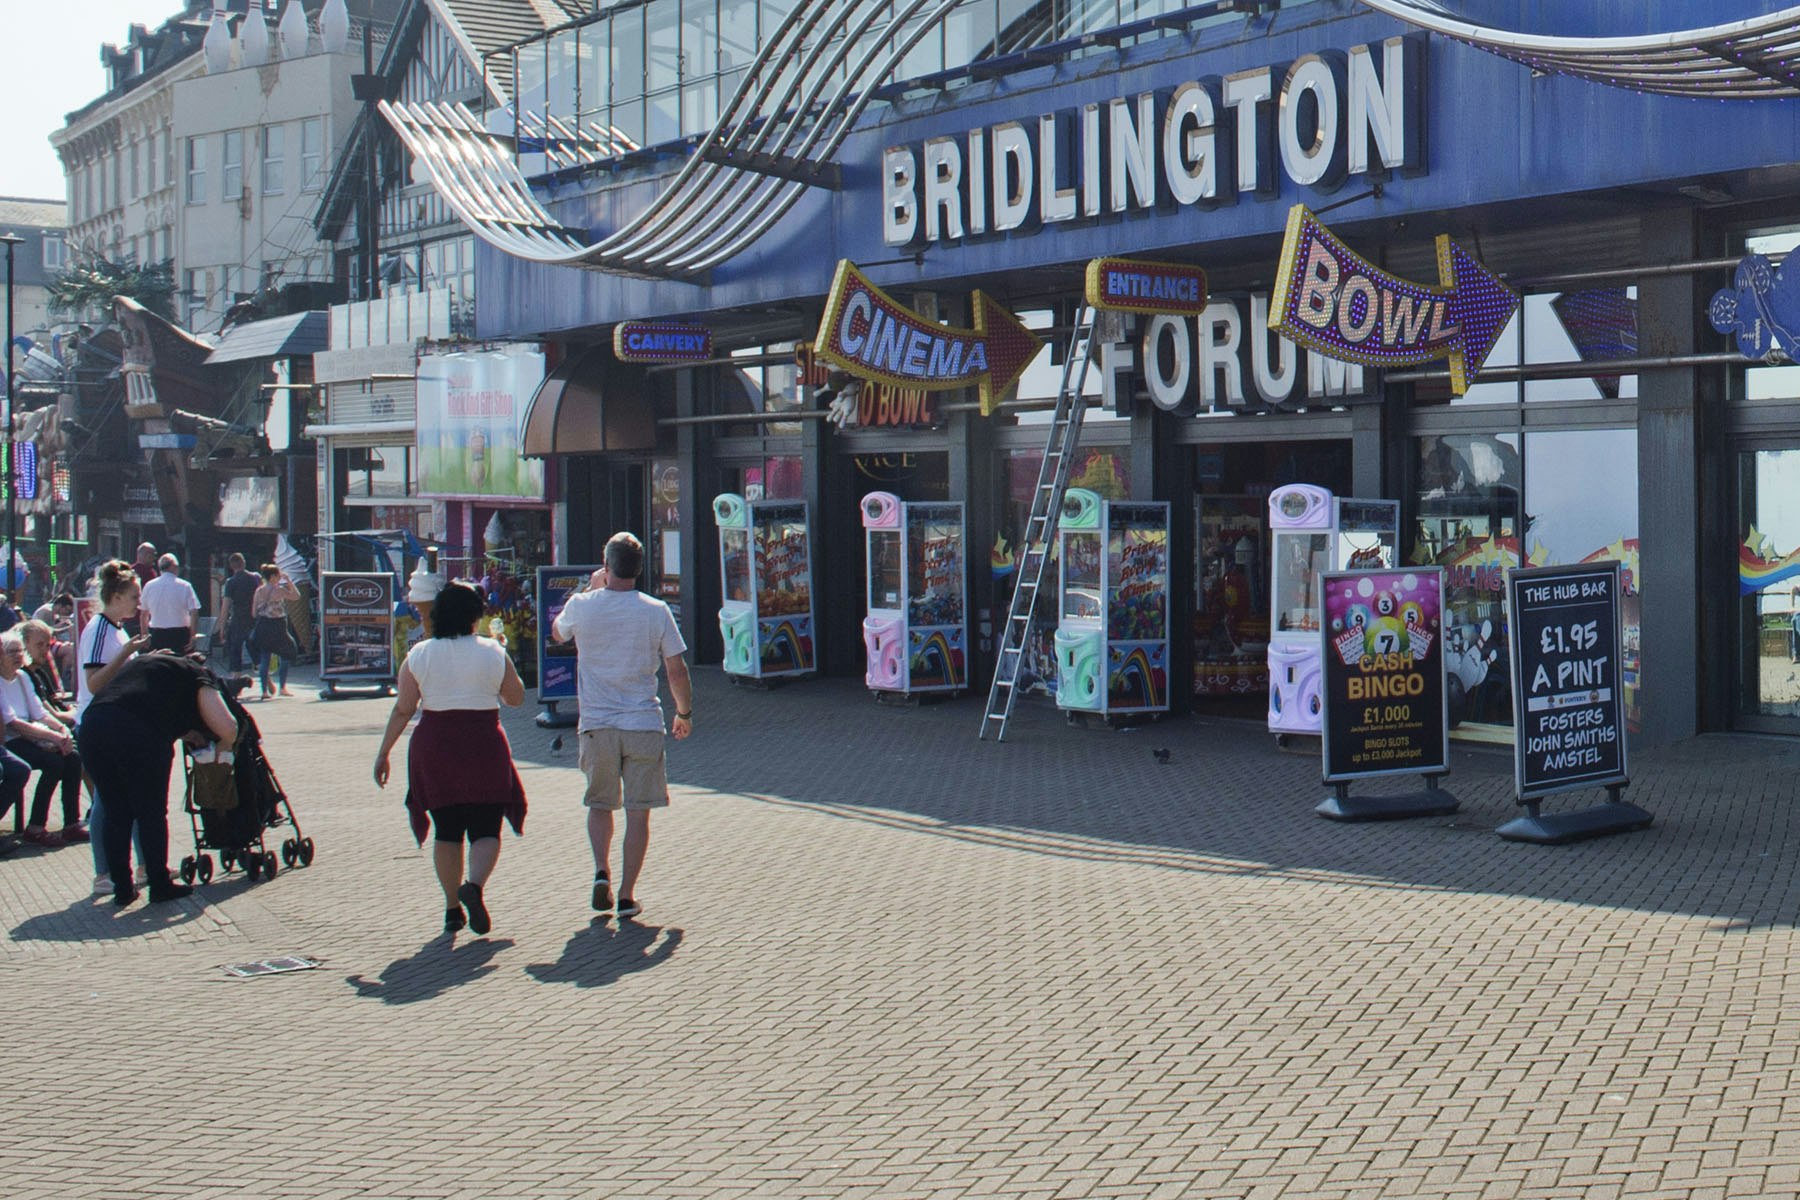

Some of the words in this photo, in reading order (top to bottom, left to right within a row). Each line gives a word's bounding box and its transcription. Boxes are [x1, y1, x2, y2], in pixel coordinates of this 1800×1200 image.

[882, 35, 1406, 248] BRIDLINGTON
[1107, 271, 1199, 301] ENTRANCE
[1296, 236, 1461, 346] BOWL
[627, 333, 705, 351] CARVERY
[839, 290, 989, 378] CINEMA
[337, 587, 379, 599] LODGE
[1525, 586, 1551, 603] THE
[1553, 583, 1579, 600] HUB
[1581, 581, 1607, 597] BAR
[1381, 600, 1390, 612] 3
[1355, 614, 1364, 625] 9
[1407, 612, 1415, 623] 5
[1335, 625, 1362, 645] BINGO
[1407, 622, 1433, 641] BINGO
[1540, 620, 1598, 654] £1.95
[1380, 635, 1394, 655] 7
[1359, 649, 1414, 673] CASH
[1531, 663, 1552, 693] A
[1557, 656, 1608, 689] PINT
[1348, 673, 1424, 700] BINGO
[1363, 704, 1410, 724] £1,000
[1540, 707, 1604, 733] FOSTERS
[1364, 738, 1387, 749] BINGO
[1388, 736, 1410, 748] SLOTS
[1526, 733, 1561, 755] JOHN
[1564, 725, 1616, 749] SMITHS
[1352, 754, 1361, 763] up
[1363, 752, 1370, 761] to
[1395, 748, 1423, 760] Jackpot
[1543, 746, 1603, 772] AMSTEL
